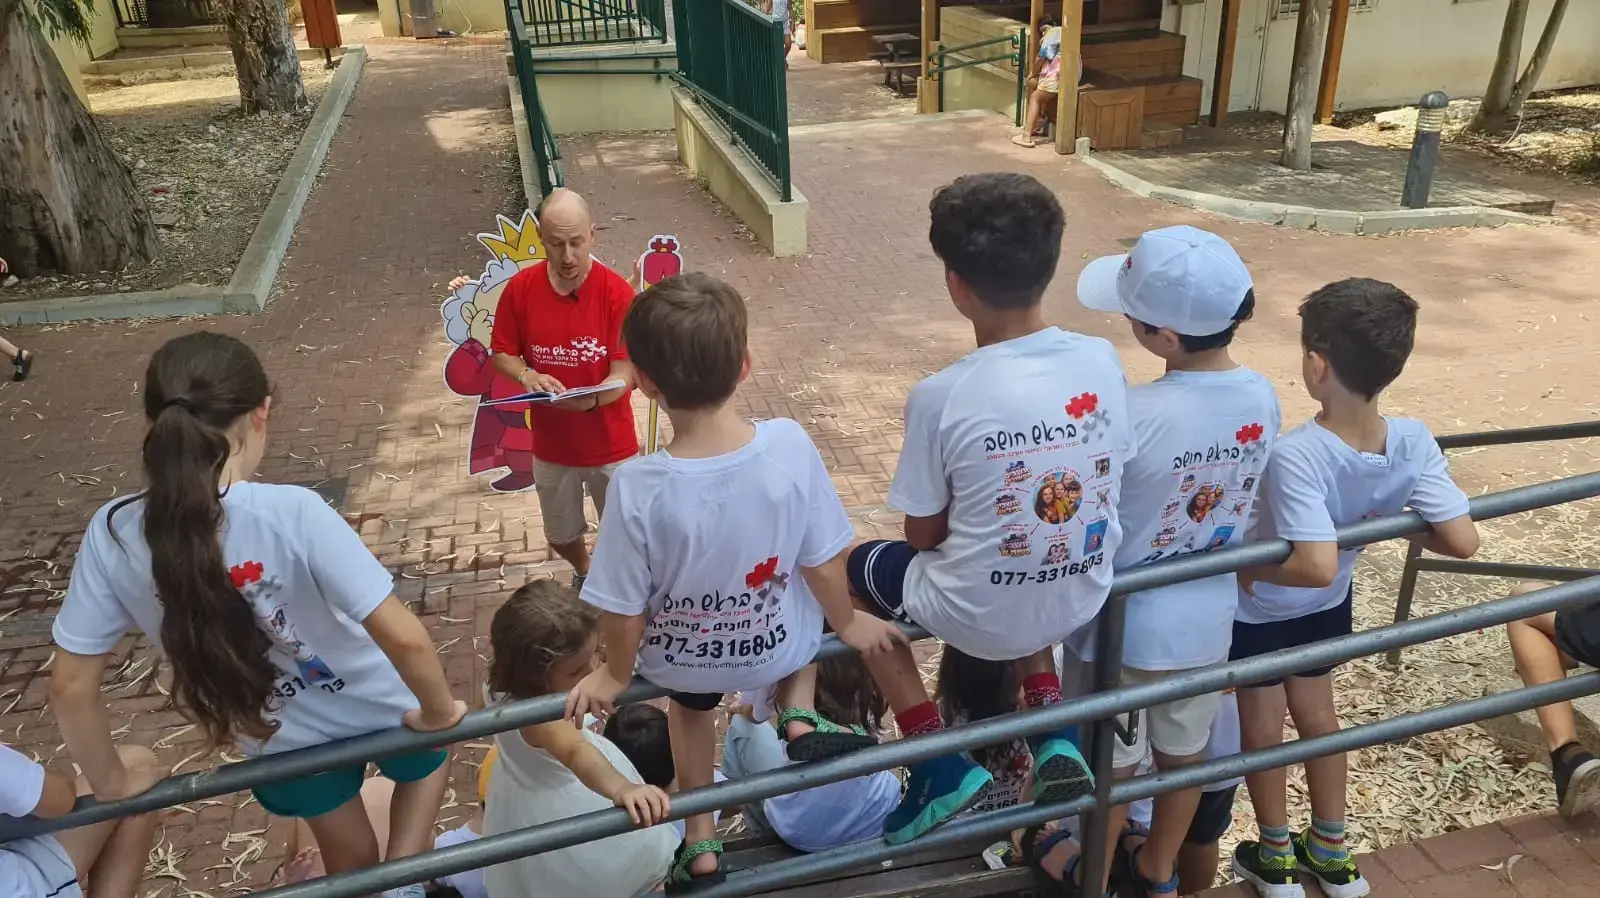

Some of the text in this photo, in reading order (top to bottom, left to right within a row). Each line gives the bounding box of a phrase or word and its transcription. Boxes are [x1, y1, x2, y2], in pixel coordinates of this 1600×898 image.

[553, 345, 578, 356] בראש
[984, 420, 1077, 453] בראש חושב
[1173, 450, 1202, 470] חושב
[1206, 441, 1240, 463] בראש
[990, 552, 1103, 585] 077-3316803
[663, 590, 751, 613] בראש חוש
[713, 619, 751, 632] חוגים
[671, 655, 774, 669] www.activeminds.co.il
